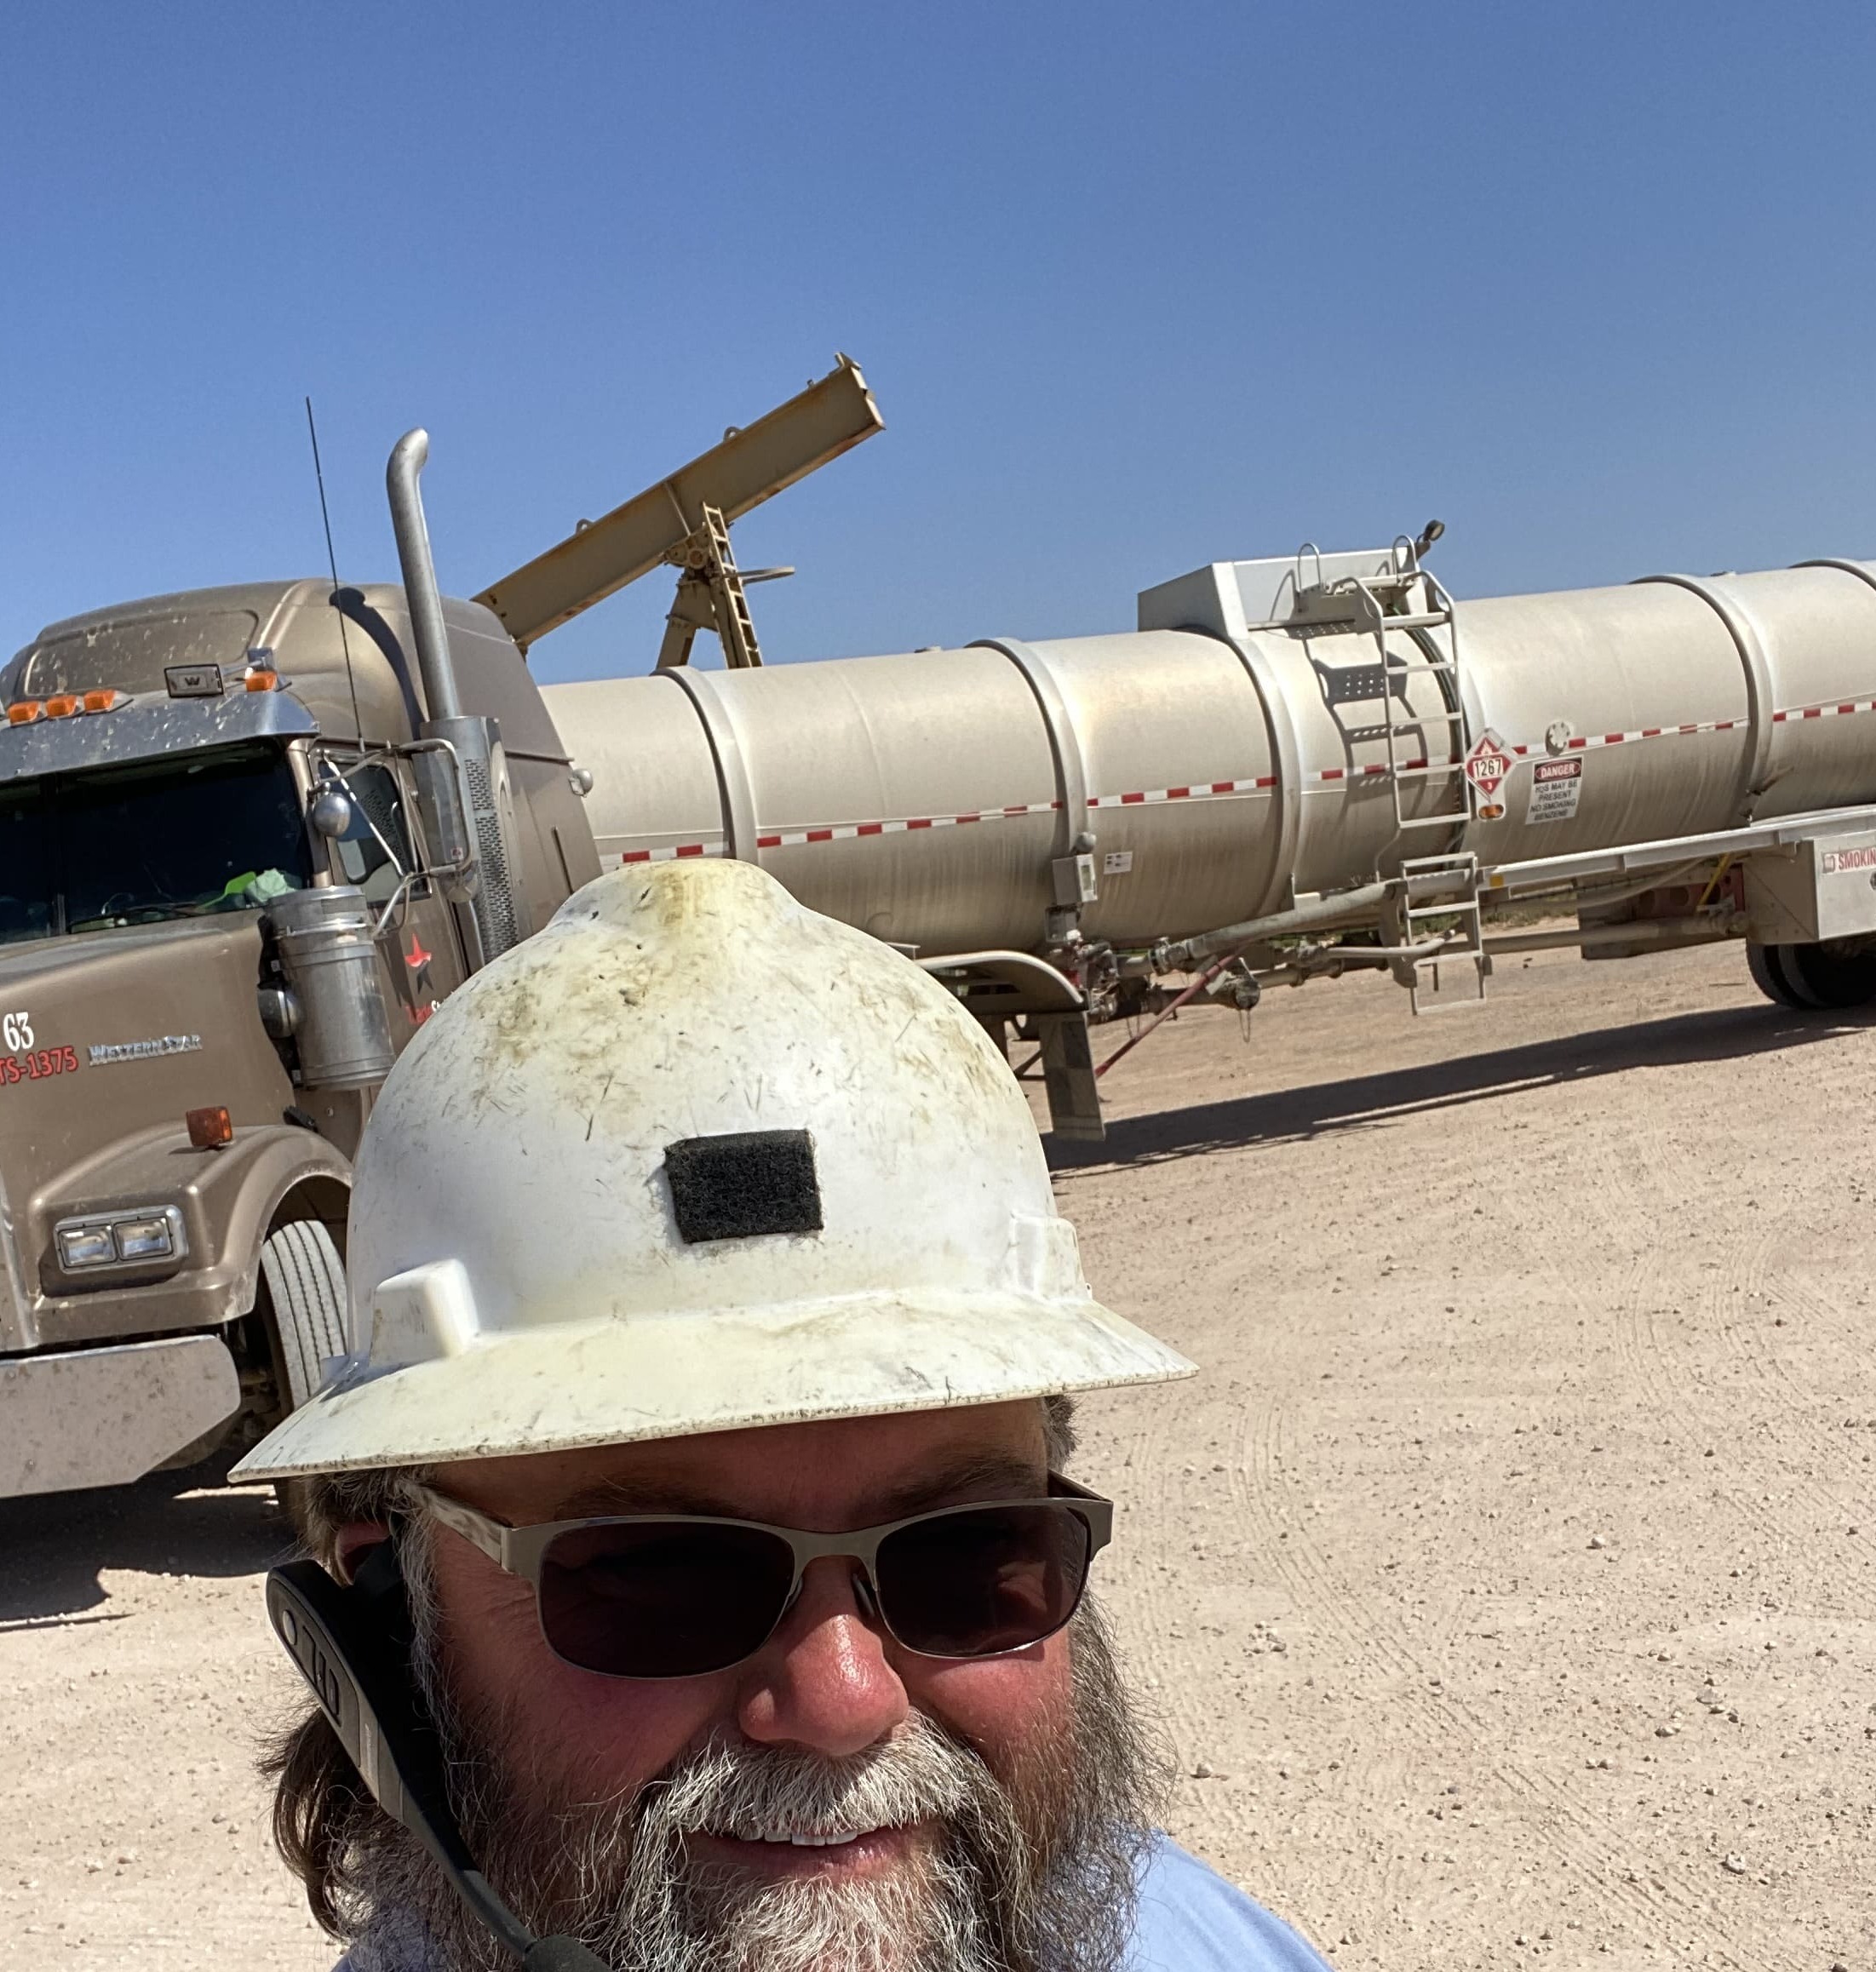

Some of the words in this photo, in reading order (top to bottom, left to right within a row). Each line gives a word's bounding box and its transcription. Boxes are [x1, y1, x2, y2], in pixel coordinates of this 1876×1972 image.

[1475, 759, 1501, 778] 1267
[1540, 763, 1575, 779] DANGER
[1551, 782, 1567, 791] MAY
[1568, 779, 1578, 788] BE
[1538, 789, 1572, 802] PRESENT
[1530, 804, 1542, 813] NO
[1543, 798, 1576, 811] SMOKING
[3, 1011, 34, 1052] 63
